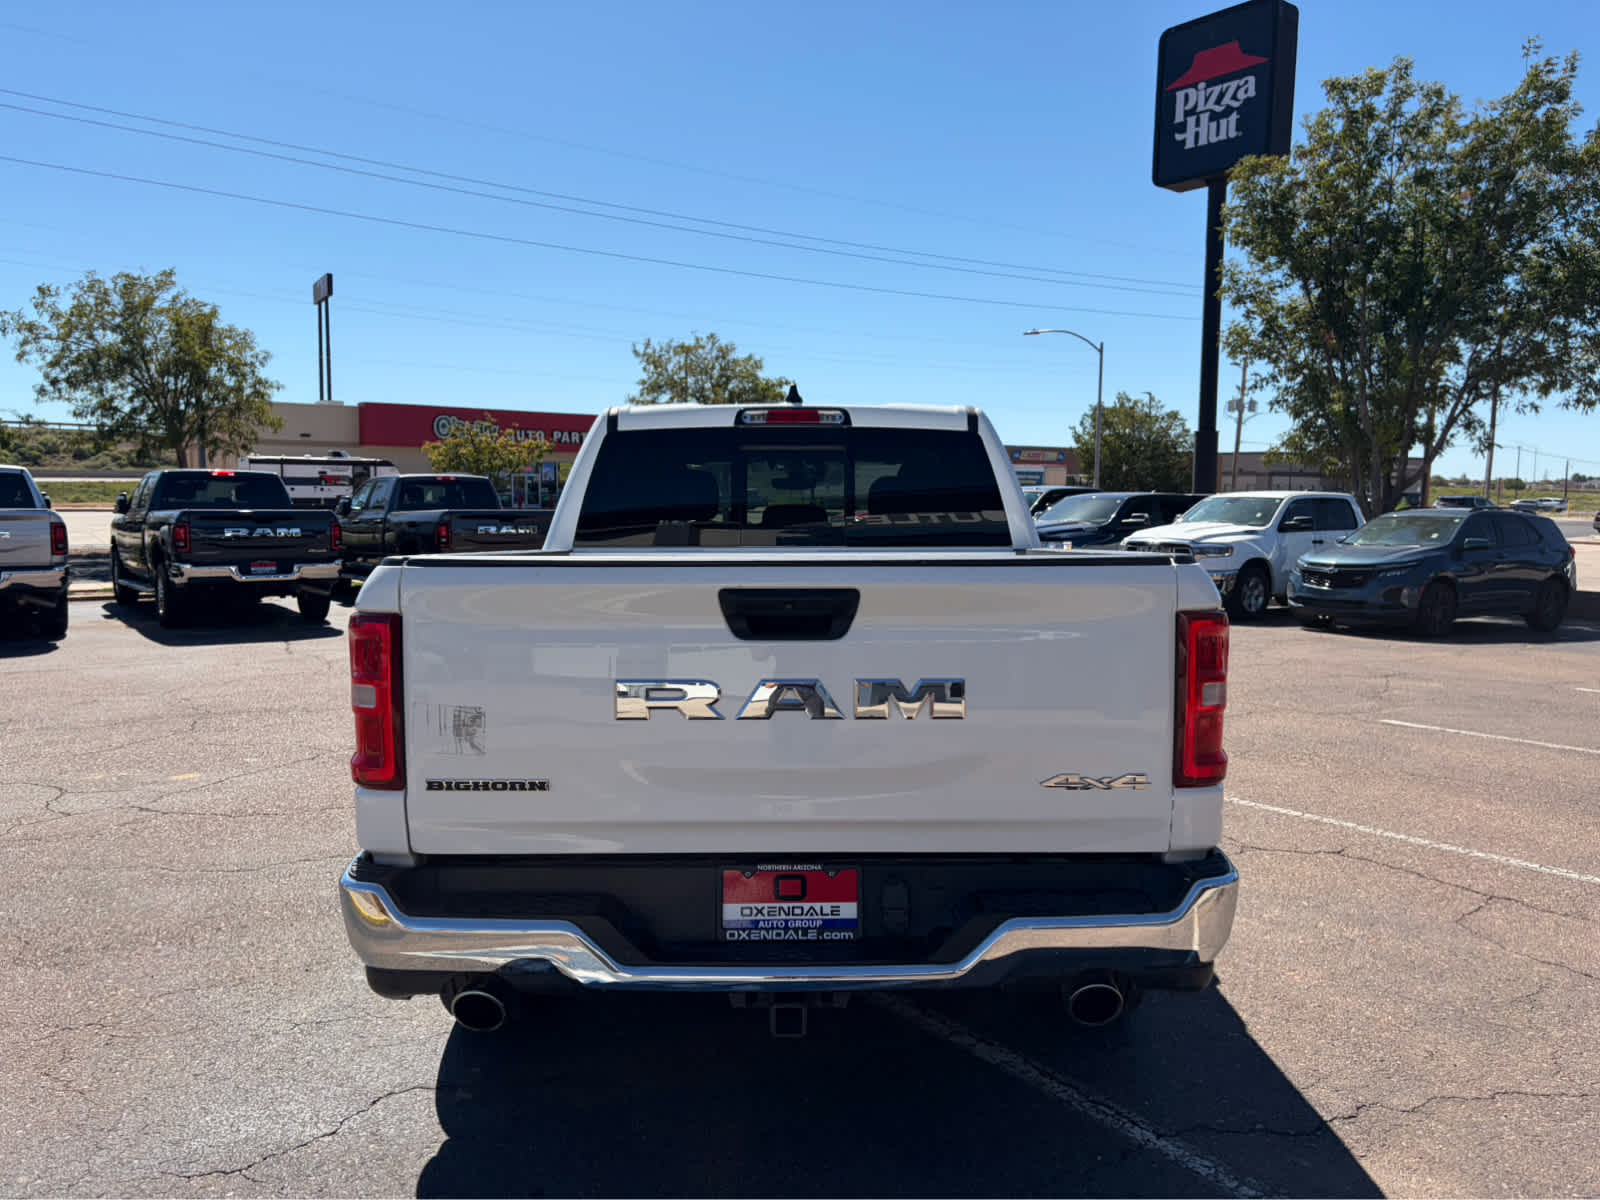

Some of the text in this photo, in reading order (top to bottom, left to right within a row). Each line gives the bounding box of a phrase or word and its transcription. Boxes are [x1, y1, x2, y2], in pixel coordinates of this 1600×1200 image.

[1173, 75, 1256, 124] Pizza
[1174, 110, 1239, 150] Hut
[224, 527, 302, 537] RAM
[615, 678, 966, 720] RAM
[426, 778, 550, 792] BIGHORN
[740, 905, 841, 917] OXENDALE
[758, 920, 823, 928] AUTO GROUP
[726, 929, 854, 941] OXENDALE.com
